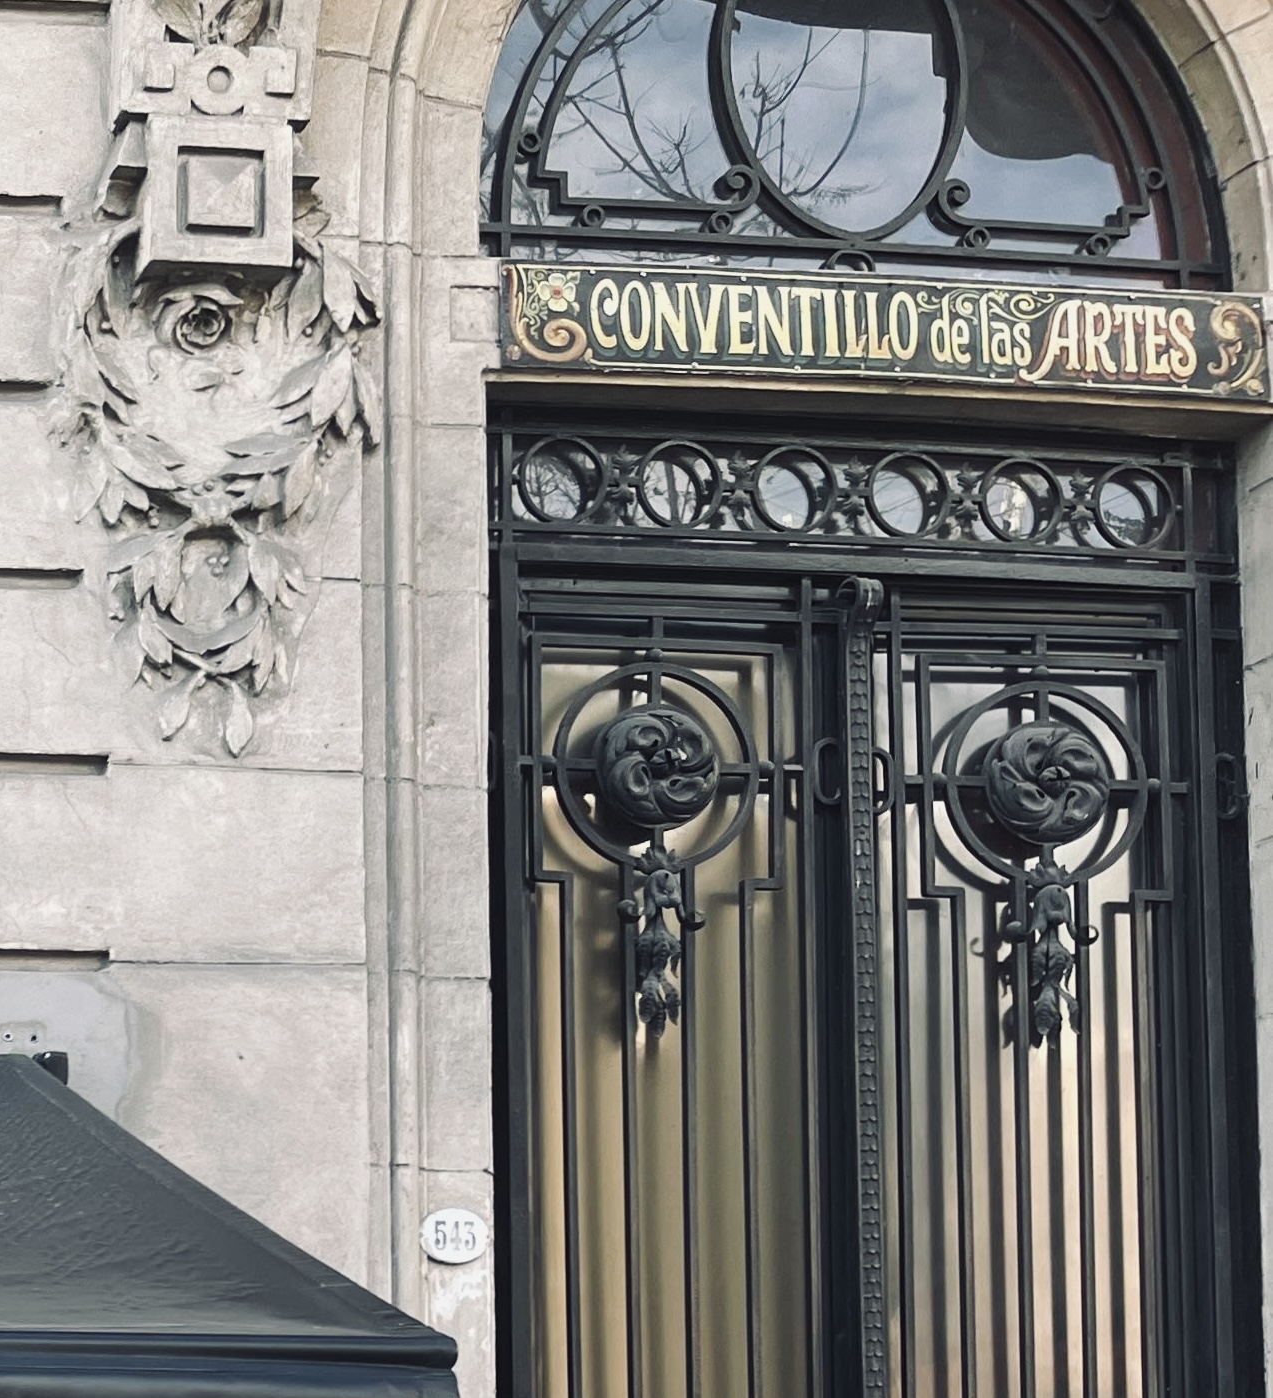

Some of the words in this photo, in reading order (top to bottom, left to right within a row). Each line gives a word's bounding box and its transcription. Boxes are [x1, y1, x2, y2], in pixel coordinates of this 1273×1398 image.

[589, 278, 919, 361] CONVENTILLO
[930, 293, 971, 364] de
[979, 294, 1032, 366] las
[1018, 299, 1198, 382] ARTES
[434, 1220, 476, 1251] 543
